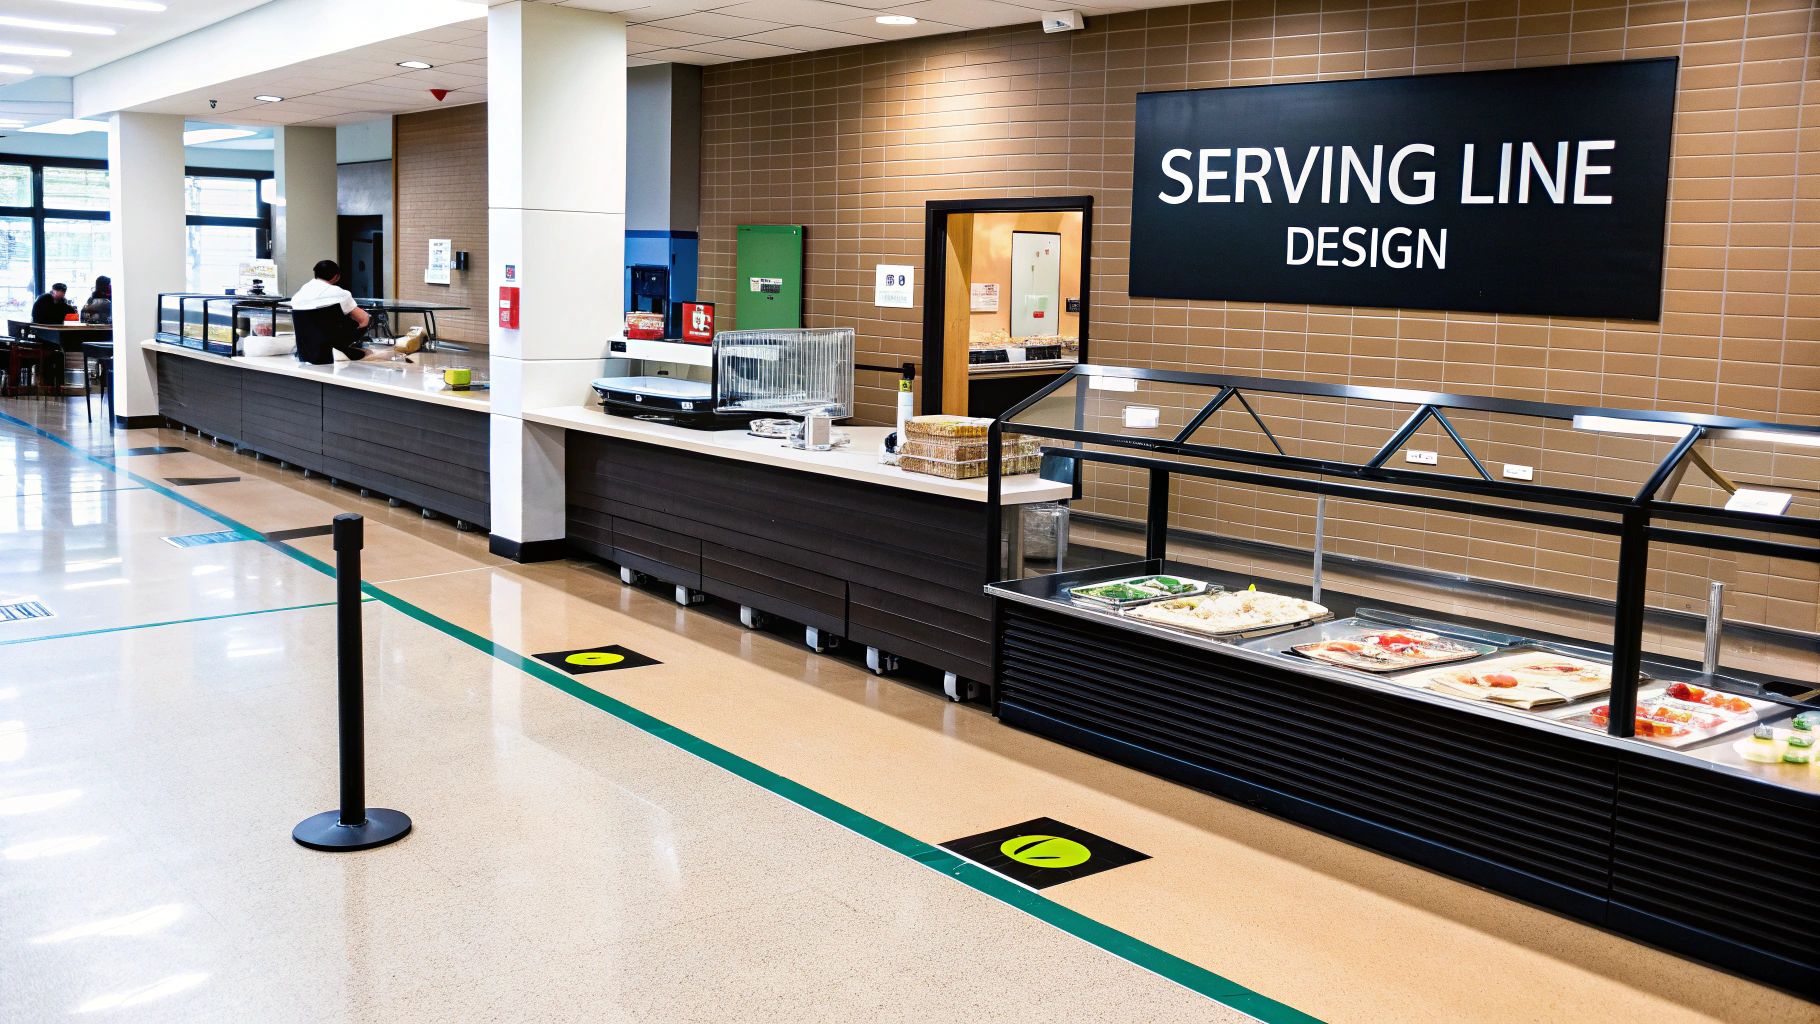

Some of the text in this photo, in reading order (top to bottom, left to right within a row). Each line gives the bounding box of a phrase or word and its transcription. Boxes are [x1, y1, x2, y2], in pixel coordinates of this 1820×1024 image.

[1157, 139, 1616, 205] SERVING LINE
[1286, 226, 1448, 270] DESIGN
